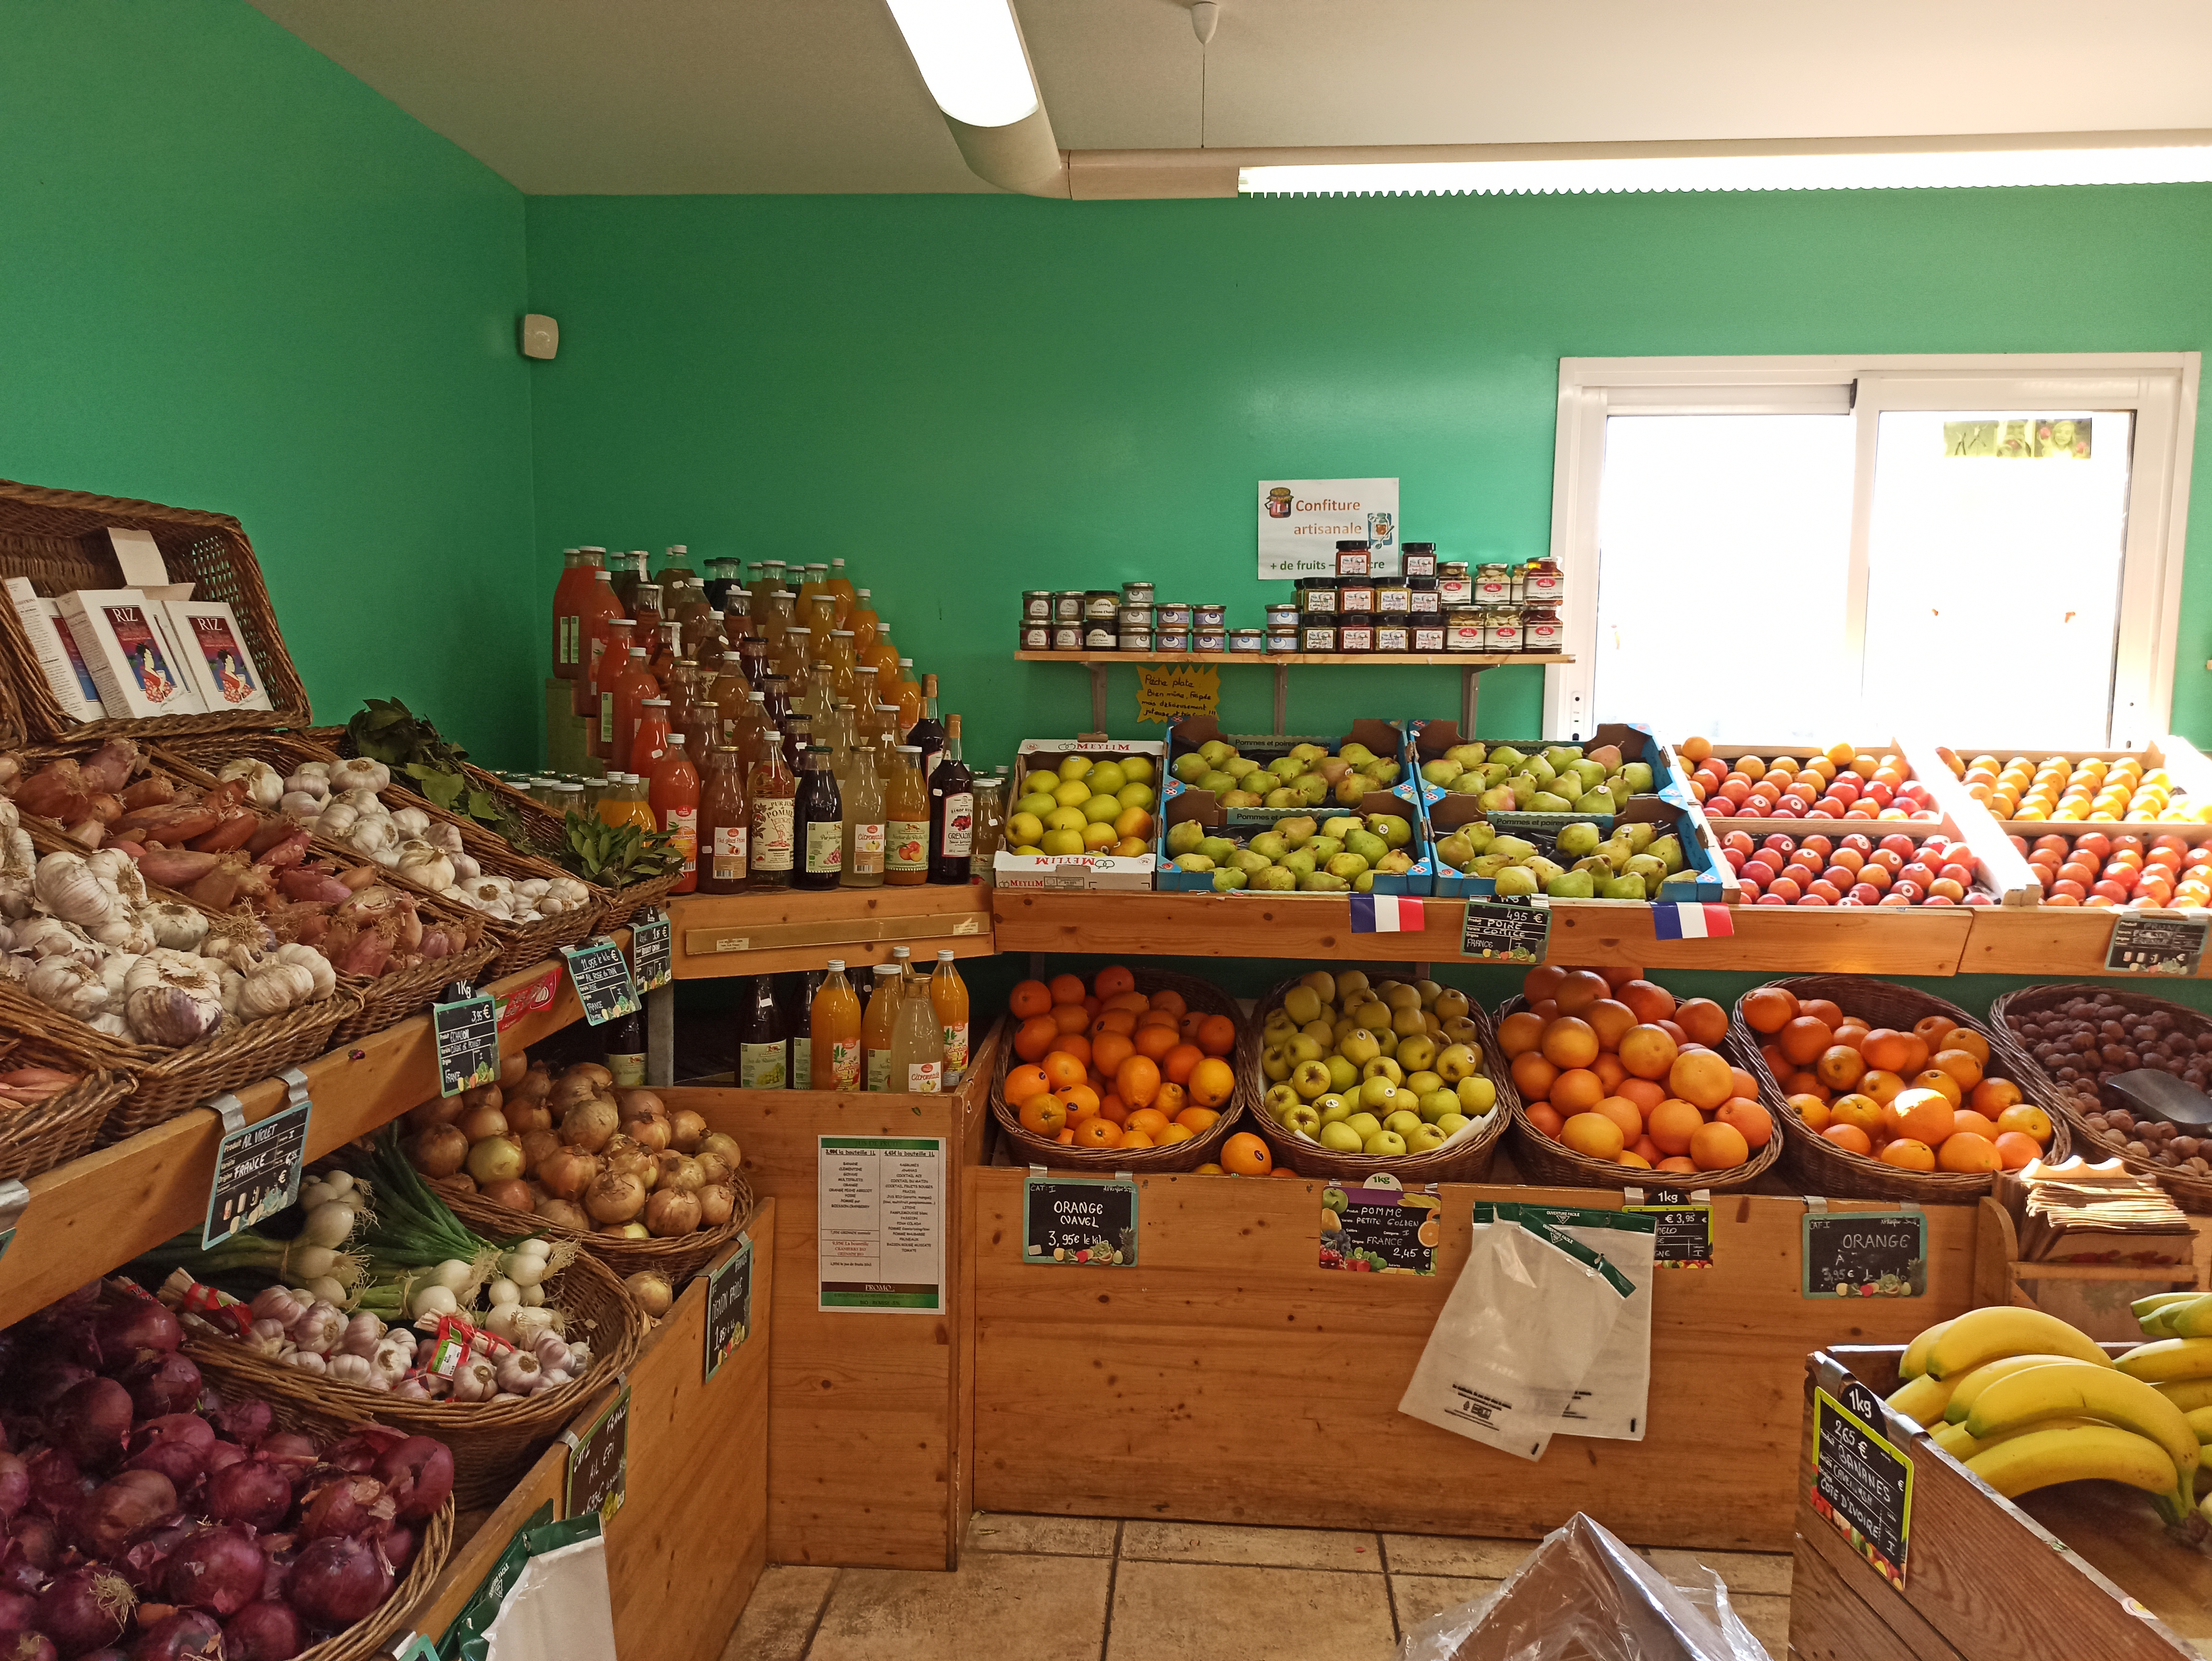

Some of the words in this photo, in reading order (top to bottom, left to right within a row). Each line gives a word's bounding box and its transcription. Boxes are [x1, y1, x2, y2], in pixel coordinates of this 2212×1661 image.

[1296, 499, 1360, 511] Confiture
[1294, 522, 1361, 535] artisanale
[1280, 560, 1294, 570] de
[1297, 560, 1326, 570] fruits
[112, 608, 138, 622] RIZ
[197, 618, 222, 631] RIZ
[1172, 677, 1194, 687] plate
[1076, 742, 1130, 751] MEYLIM
[1035, 857, 1095, 865] MEYLIM
[1533, 913, 1543, 923] €
[1488, 919, 1522, 930] POIRE
[662, 927, 667, 937] €
[1483, 928, 1526, 937] COMICE
[1467, 939, 1493, 948] FRANCE
[610, 950, 619, 961] €
[472, 1010, 482, 1023] 3,95
[483, 1005, 490, 1019] €
[234, 1152, 266, 1178] FRANCE
[278, 1169, 287, 1184] €
[1658, 1191, 1678, 1203] 1kg
[1054, 1201, 1103, 1214] ORANGE
[1361, 1207, 1402, 1217] POMME
[1060, 1215, 1099, 1228] NAVEL
[1387, 1218, 1419, 1227] GOLDEN
[1665, 1214, 1673, 1223] €
[1677, 1213, 1695, 1224] 3,95
[1084, 1233, 1090, 1244] le
[1543, 1224, 1562, 1237] OUVERTURE
[1561, 1235, 1573, 1244] FACILE
[1367, 1237, 1403, 1246] FRANCE
[1843, 1234, 1911, 1249] ORANGE
[1393, 1248, 1418, 1258] 2,45
[1849, 1388, 1871, 1418] 1kg
[1858, 1441, 1868, 1459] €
[1838, 1445, 1891, 1502] BANANES
[1898, 1480, 1904, 1492] €
[1841, 1494, 1880, 1539] D'IVOIRE
